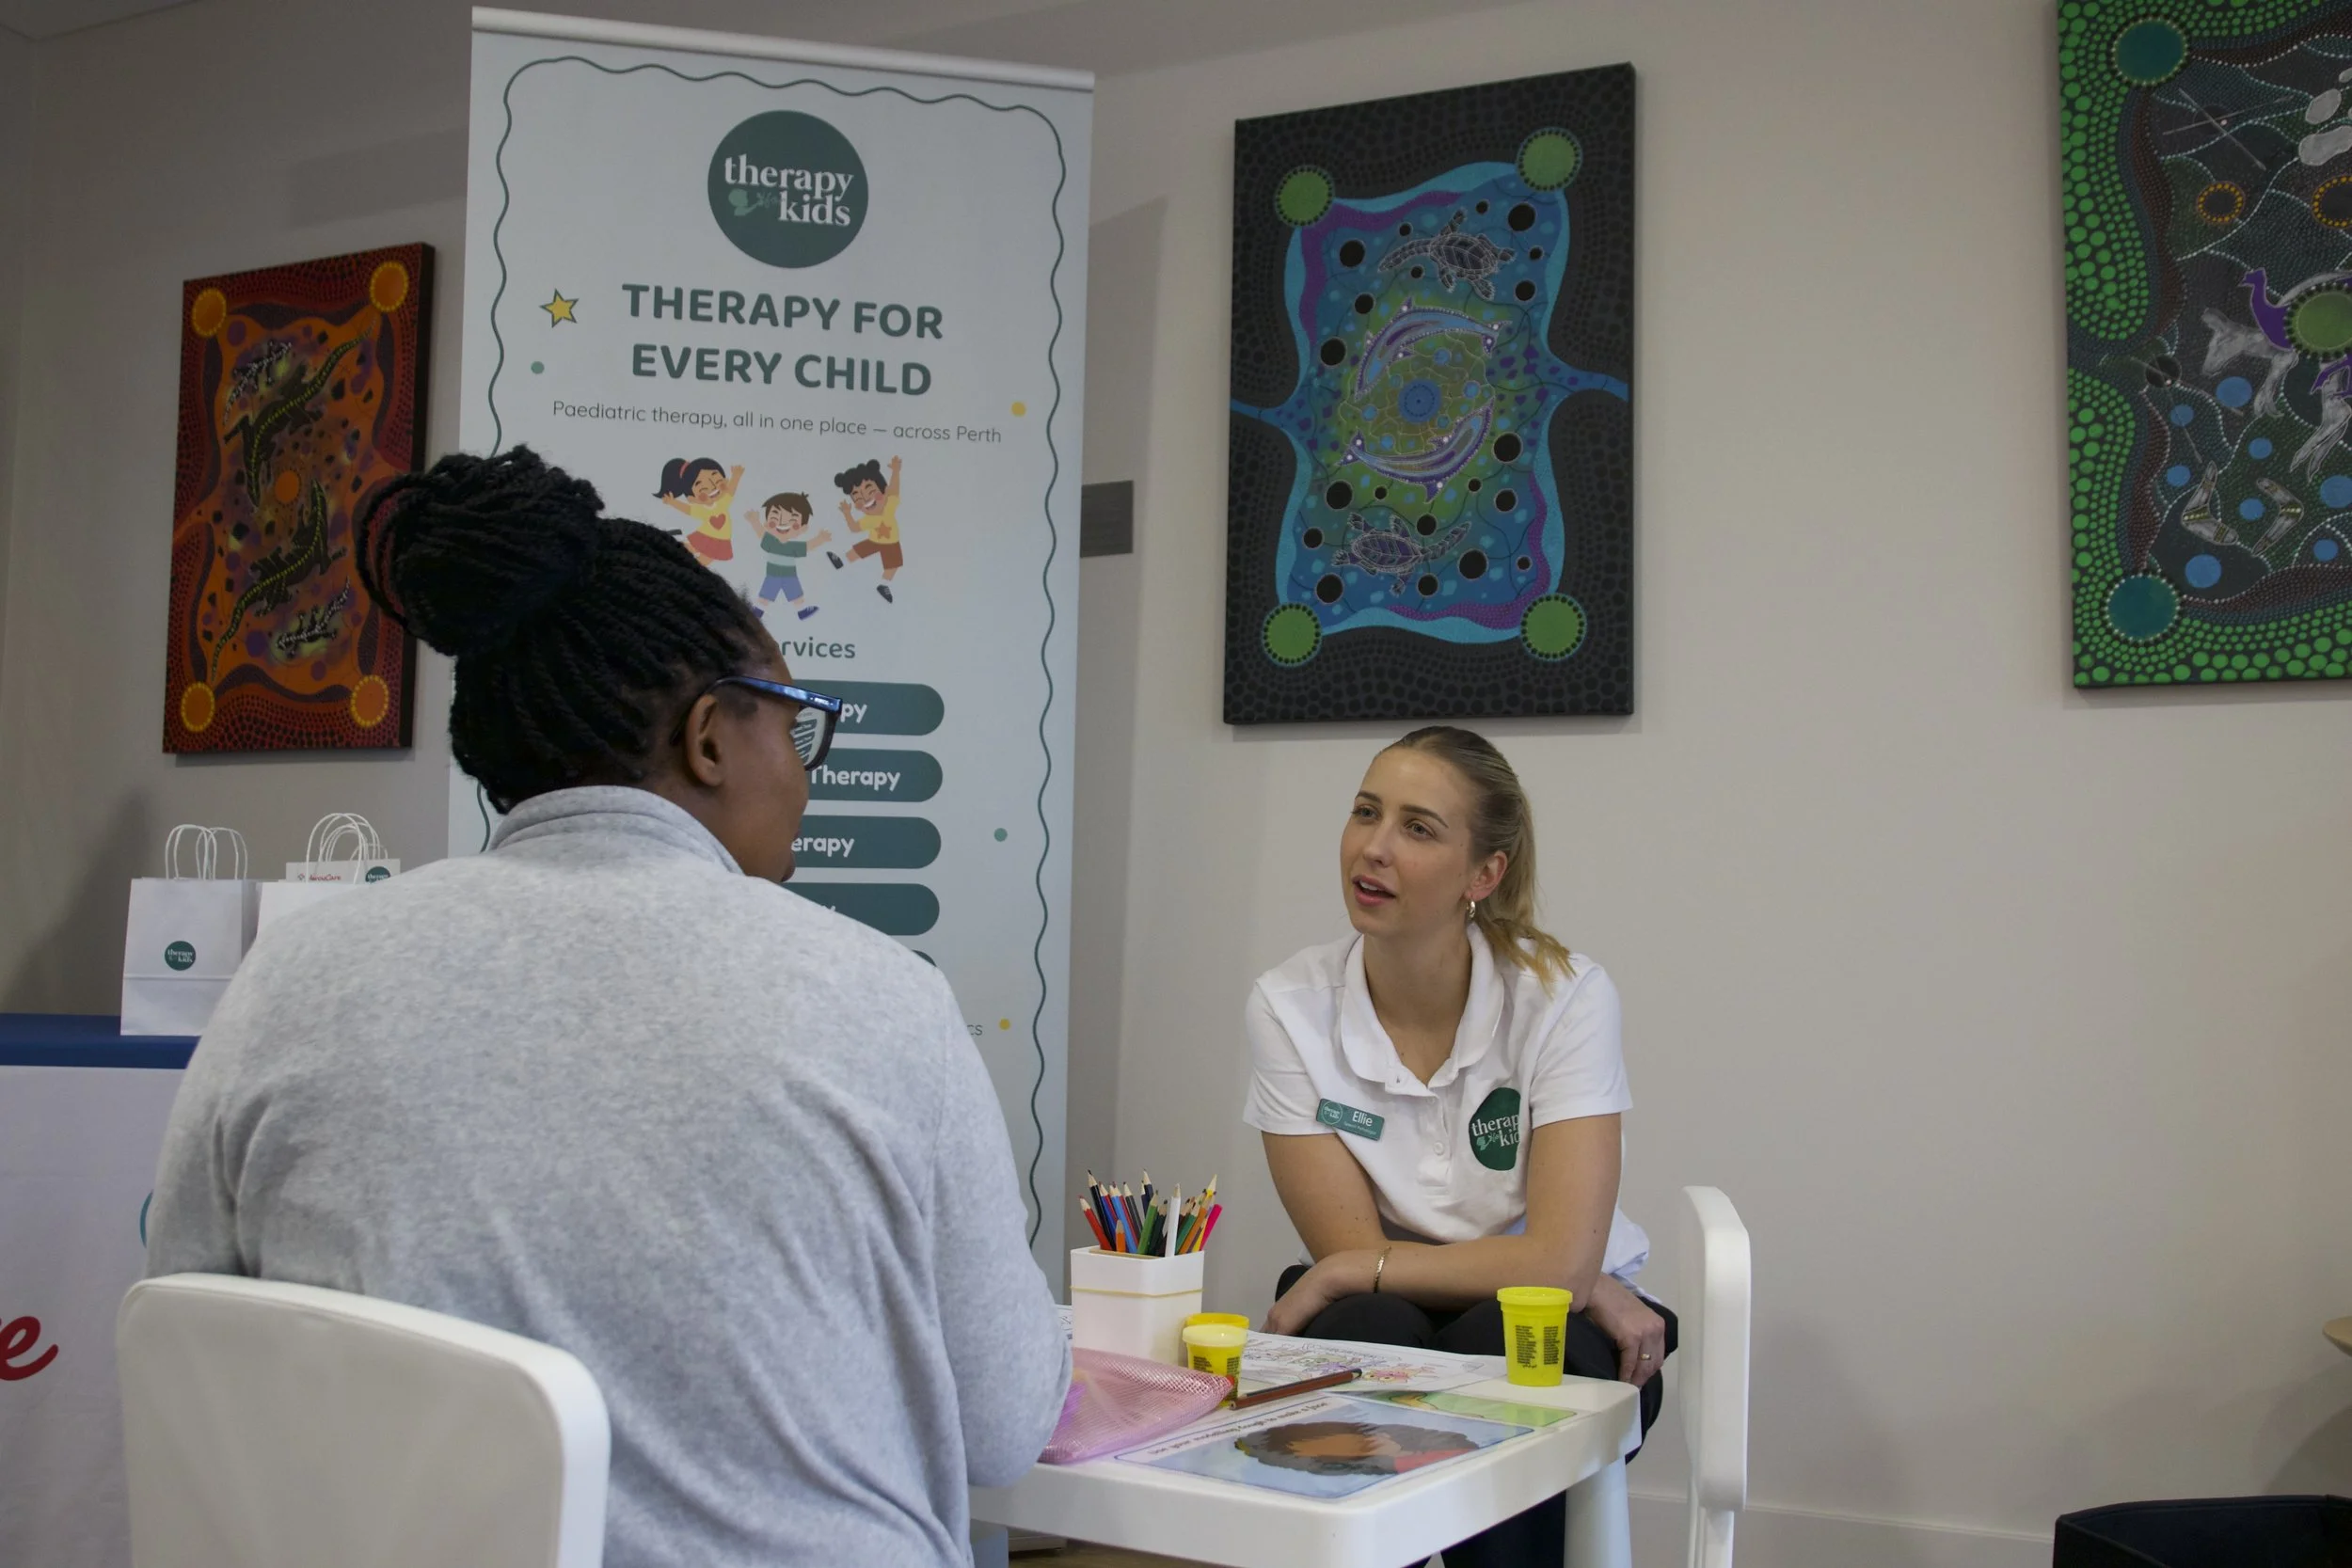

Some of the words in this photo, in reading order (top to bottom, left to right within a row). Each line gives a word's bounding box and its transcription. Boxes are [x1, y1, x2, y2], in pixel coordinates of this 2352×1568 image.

[724, 153, 854, 202] therapy
[778, 190, 851, 227] kids
[622, 283, 840, 330] THERAPY
[854, 301, 943, 339] FOR
[632, 343, 782, 385] EVERY
[794, 354, 931, 396] CHILD
[553, 400, 646, 421] Paediatric
[651, 406, 727, 430] therapy,
[733, 411, 754, 427] all
[759, 414, 774, 428] in
[780, 418, 814, 432] one
[819, 417, 866, 436] place
[893, 425, 950, 440] across
[957, 425, 1001, 443] Perth
[781, 636, 856, 659] rvices
[790, 837, 855, 858] erapy
[1352, 1110, 1374, 1127] Ellie
[1471, 1115, 1519, 1137] therap
